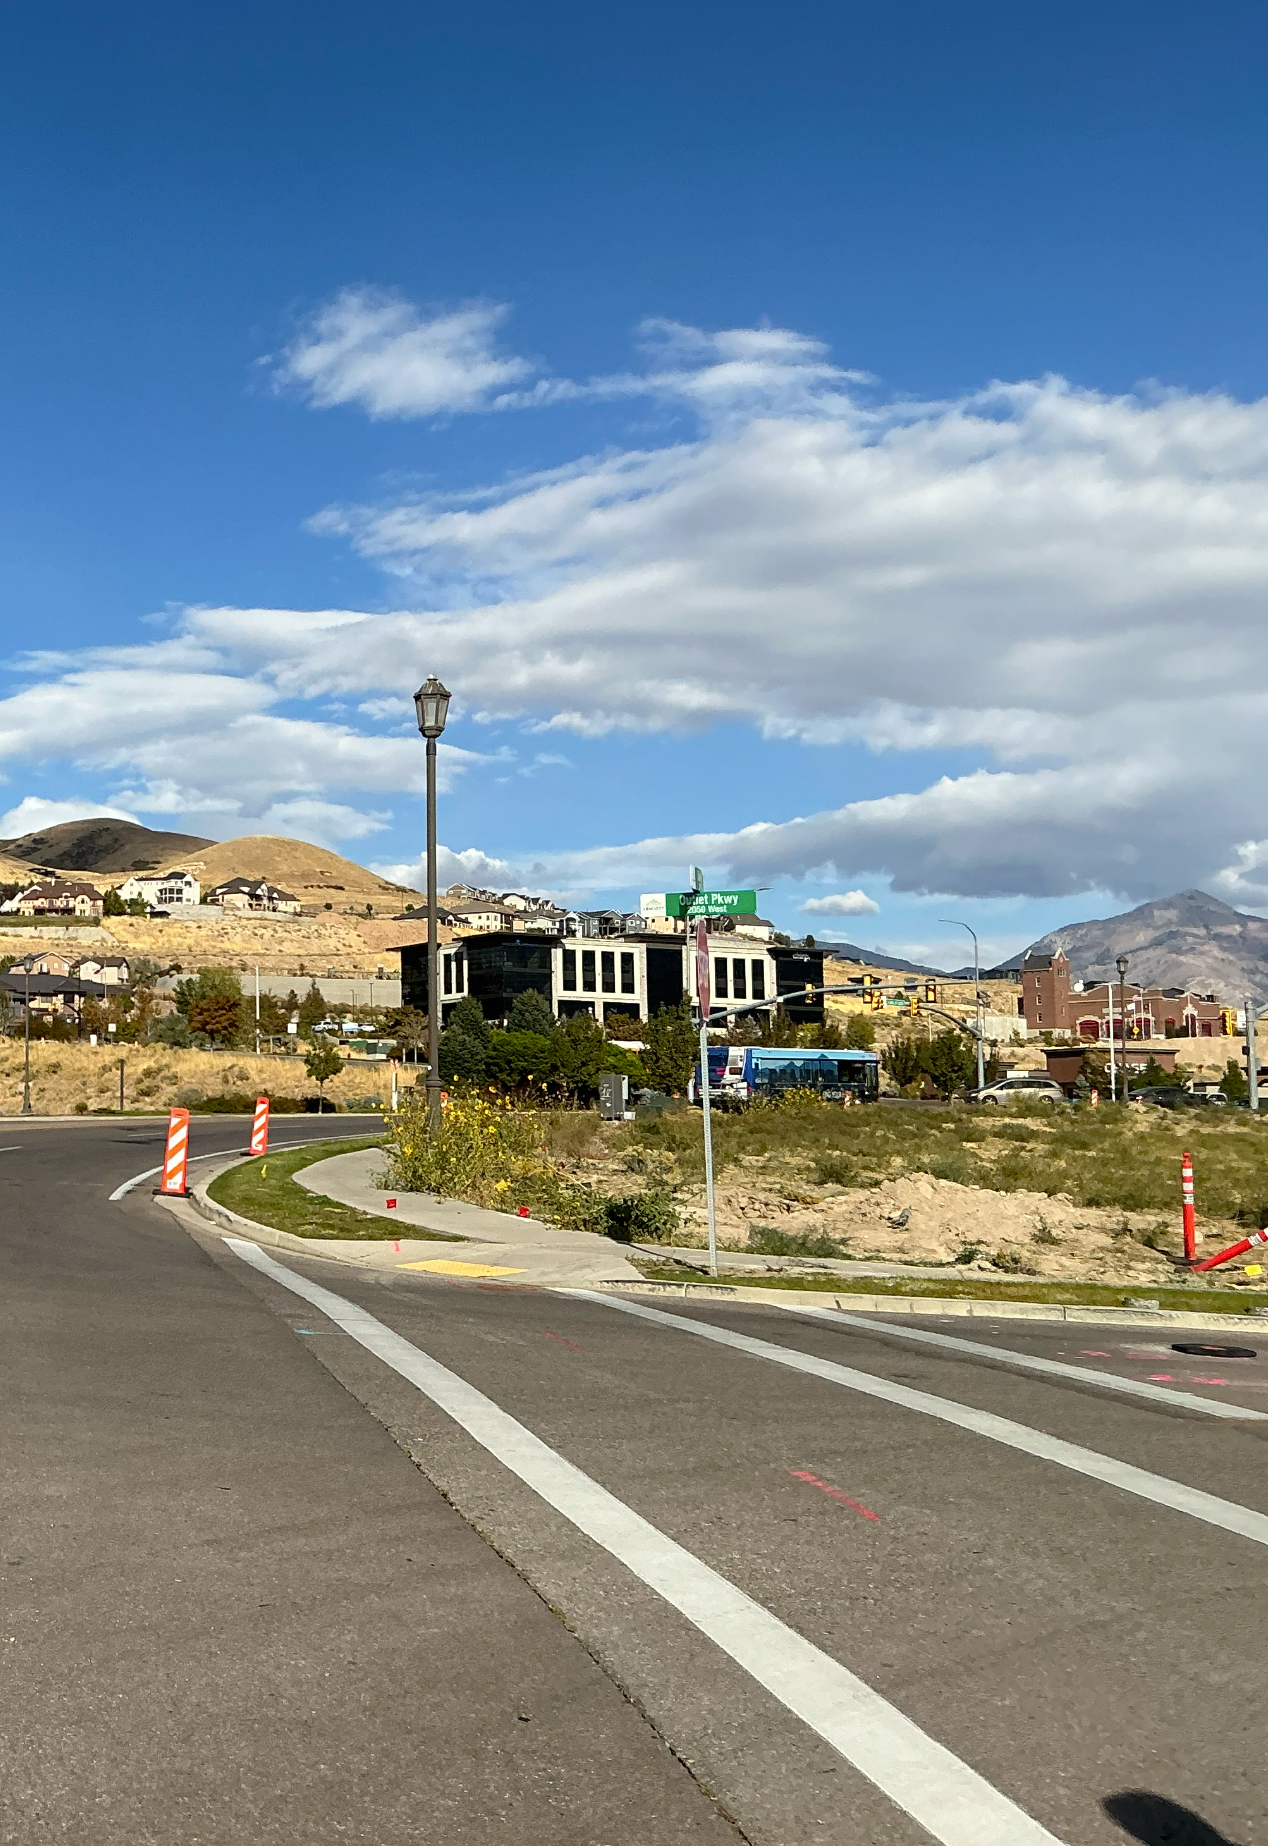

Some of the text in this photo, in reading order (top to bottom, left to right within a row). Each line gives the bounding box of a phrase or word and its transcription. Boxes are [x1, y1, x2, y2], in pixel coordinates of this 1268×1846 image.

[711, 893, 739, 906] Pkwy
[687, 905, 728, 914] 2050 West
